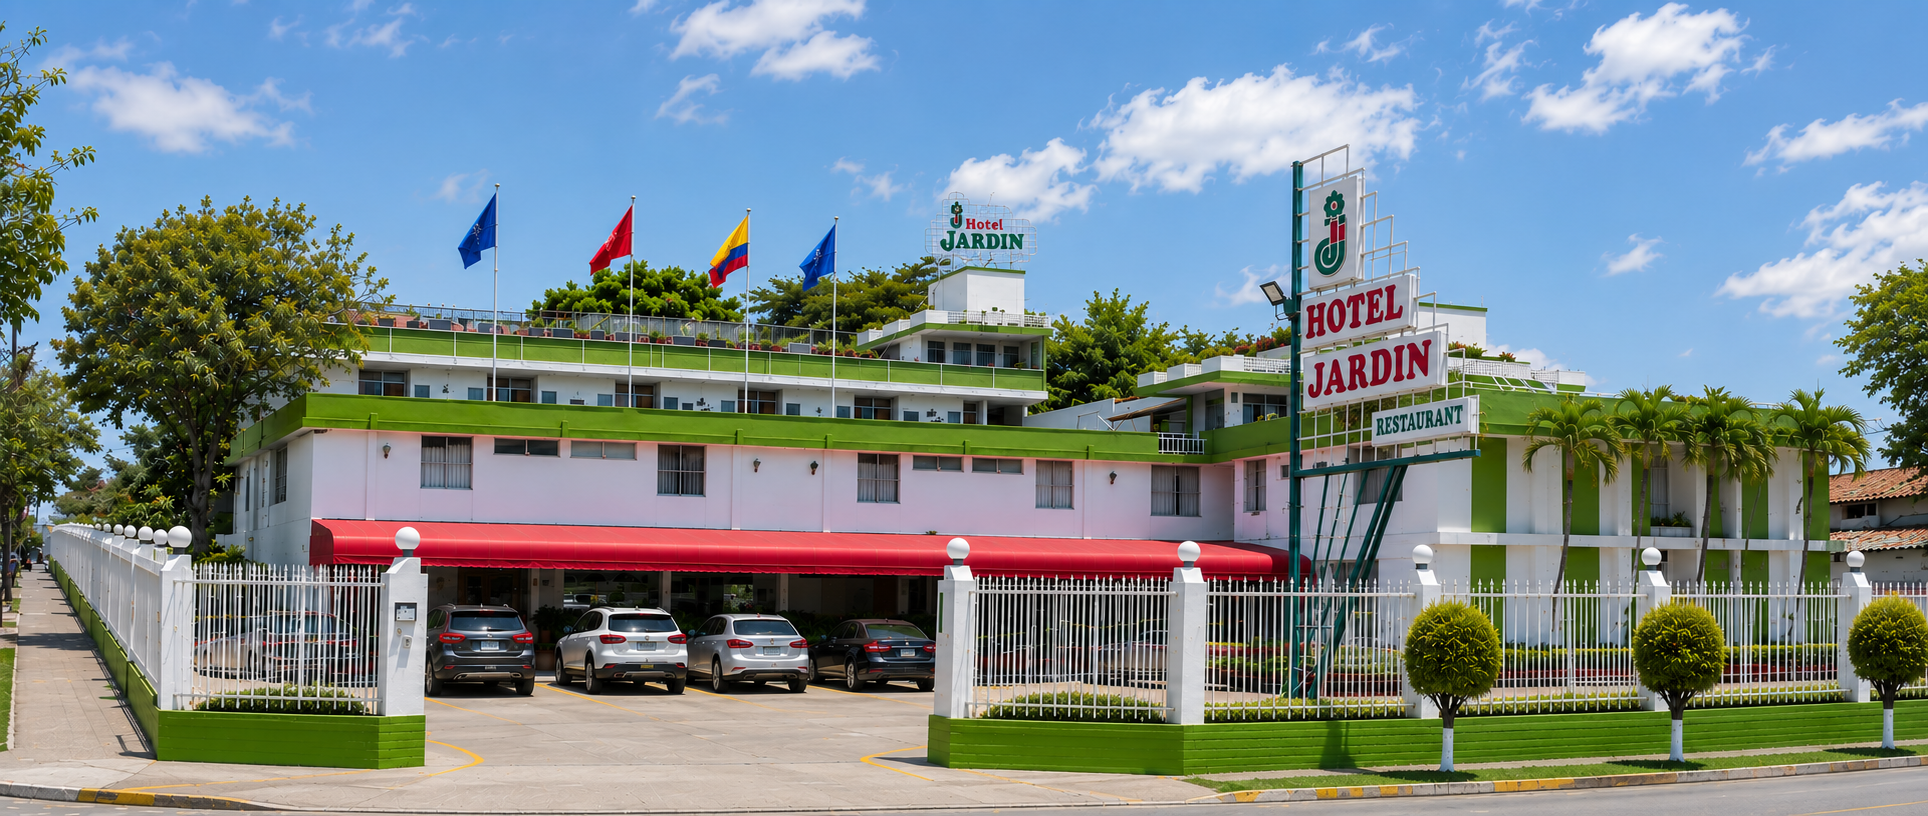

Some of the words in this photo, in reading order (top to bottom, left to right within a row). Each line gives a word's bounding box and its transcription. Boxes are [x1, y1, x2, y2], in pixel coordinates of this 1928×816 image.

[966, 218, 1003, 230] Hotel
[940, 230, 1024, 251] JARDIN
[1305, 284, 1404, 339] HOTEL
[1308, 339, 1432, 398] JARDIN
[1376, 405, 1464, 436] RESTAURANT
